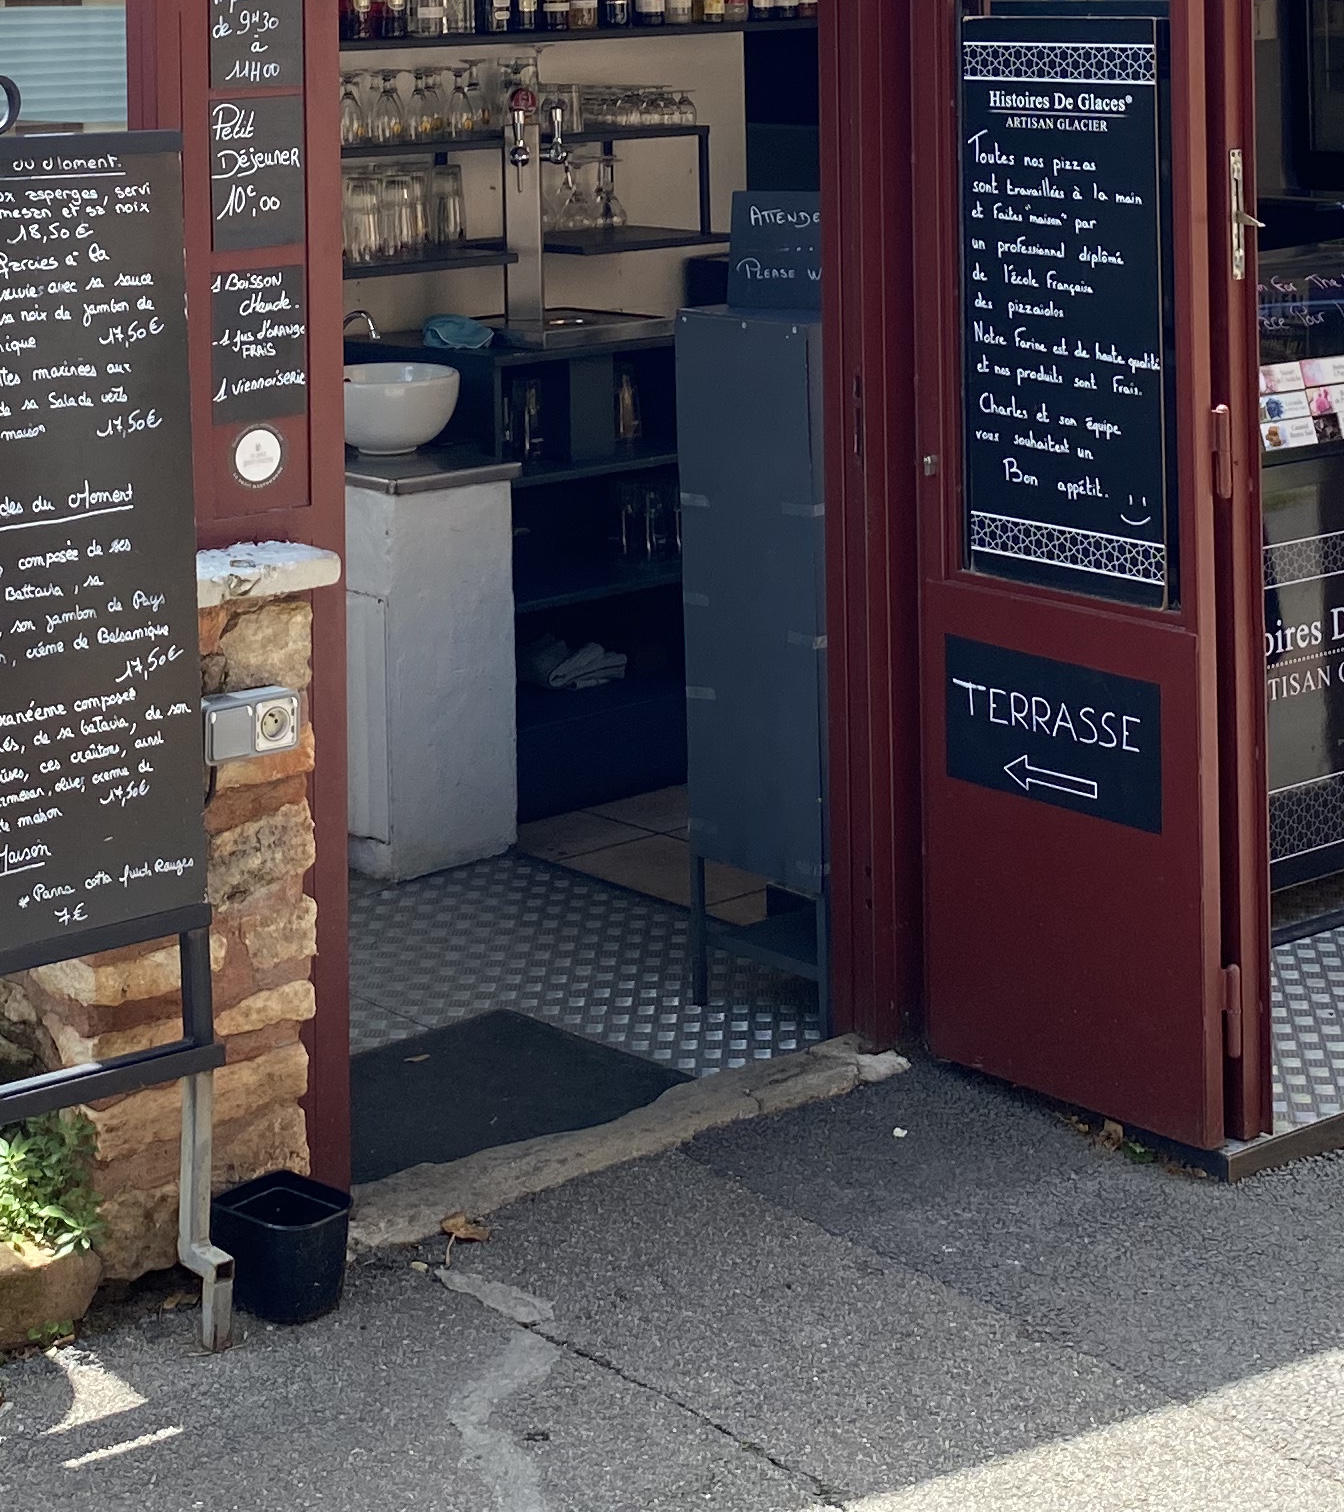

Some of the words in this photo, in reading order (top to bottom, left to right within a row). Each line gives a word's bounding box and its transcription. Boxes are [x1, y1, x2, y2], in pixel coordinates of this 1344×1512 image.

[213, 16, 232, 38] de
[989, 91, 1049, 108] Histoires
[1054, 93, 1073, 109] De
[213, 104, 254, 140] Petit
[1006, 117, 1053, 128] ARTISAN
[1057, 119, 1107, 131] GLACIER
[968, 130, 1014, 165] Toutes
[1024, 157, 1044, 167] nos
[1053, 159, 1096, 176] pizzas
[115, 182, 150, 197] servi
[973, 173, 998, 193] sont
[1007, 177, 1064, 198] travaillées
[1073, 186, 1082, 199] à
[1094, 183, 1108, 200] la
[1116, 192, 1142, 204] main
[972, 201, 983, 218] et
[1075, 219, 1096, 233] par
[972, 238, 985, 249] un
[998, 236, 1064, 258] professionnel
[1079, 246, 1124, 268] diplômé
[211, 276, 221, 292] 1
[973, 263, 987, 280] de
[1304, 273, 1342, 290] The
[975, 292, 992, 308] des
[1008, 301, 1063, 318] pizzaiolos
[232, 330, 255, 352] jus
[974, 321, 1006, 345] Notre
[1053, 338, 1068, 355] est
[1074, 341, 1090, 358] de
[1096, 343, 1125, 364] haute
[977, 355, 989, 372] et
[994, 366, 1010, 376] nos
[1017, 365, 1062, 385] produits
[1074, 373, 1097, 389] sont
[213, 378, 227, 402] 1
[980, 393, 1027, 418] Charles
[1037, 403, 1049, 422] et
[1059, 416, 1077, 426] son
[1086, 417, 1121, 439] équipe
[976, 430, 999, 441] vous
[1014, 431, 1069, 453] souhaitent
[1078, 448, 1093, 459] un
[1003, 458, 1038, 485] Bon
[33, 496, 55, 512] du
[953, 678, 1140, 752] TERRASSE
[54, 903, 88, 925] 7€
